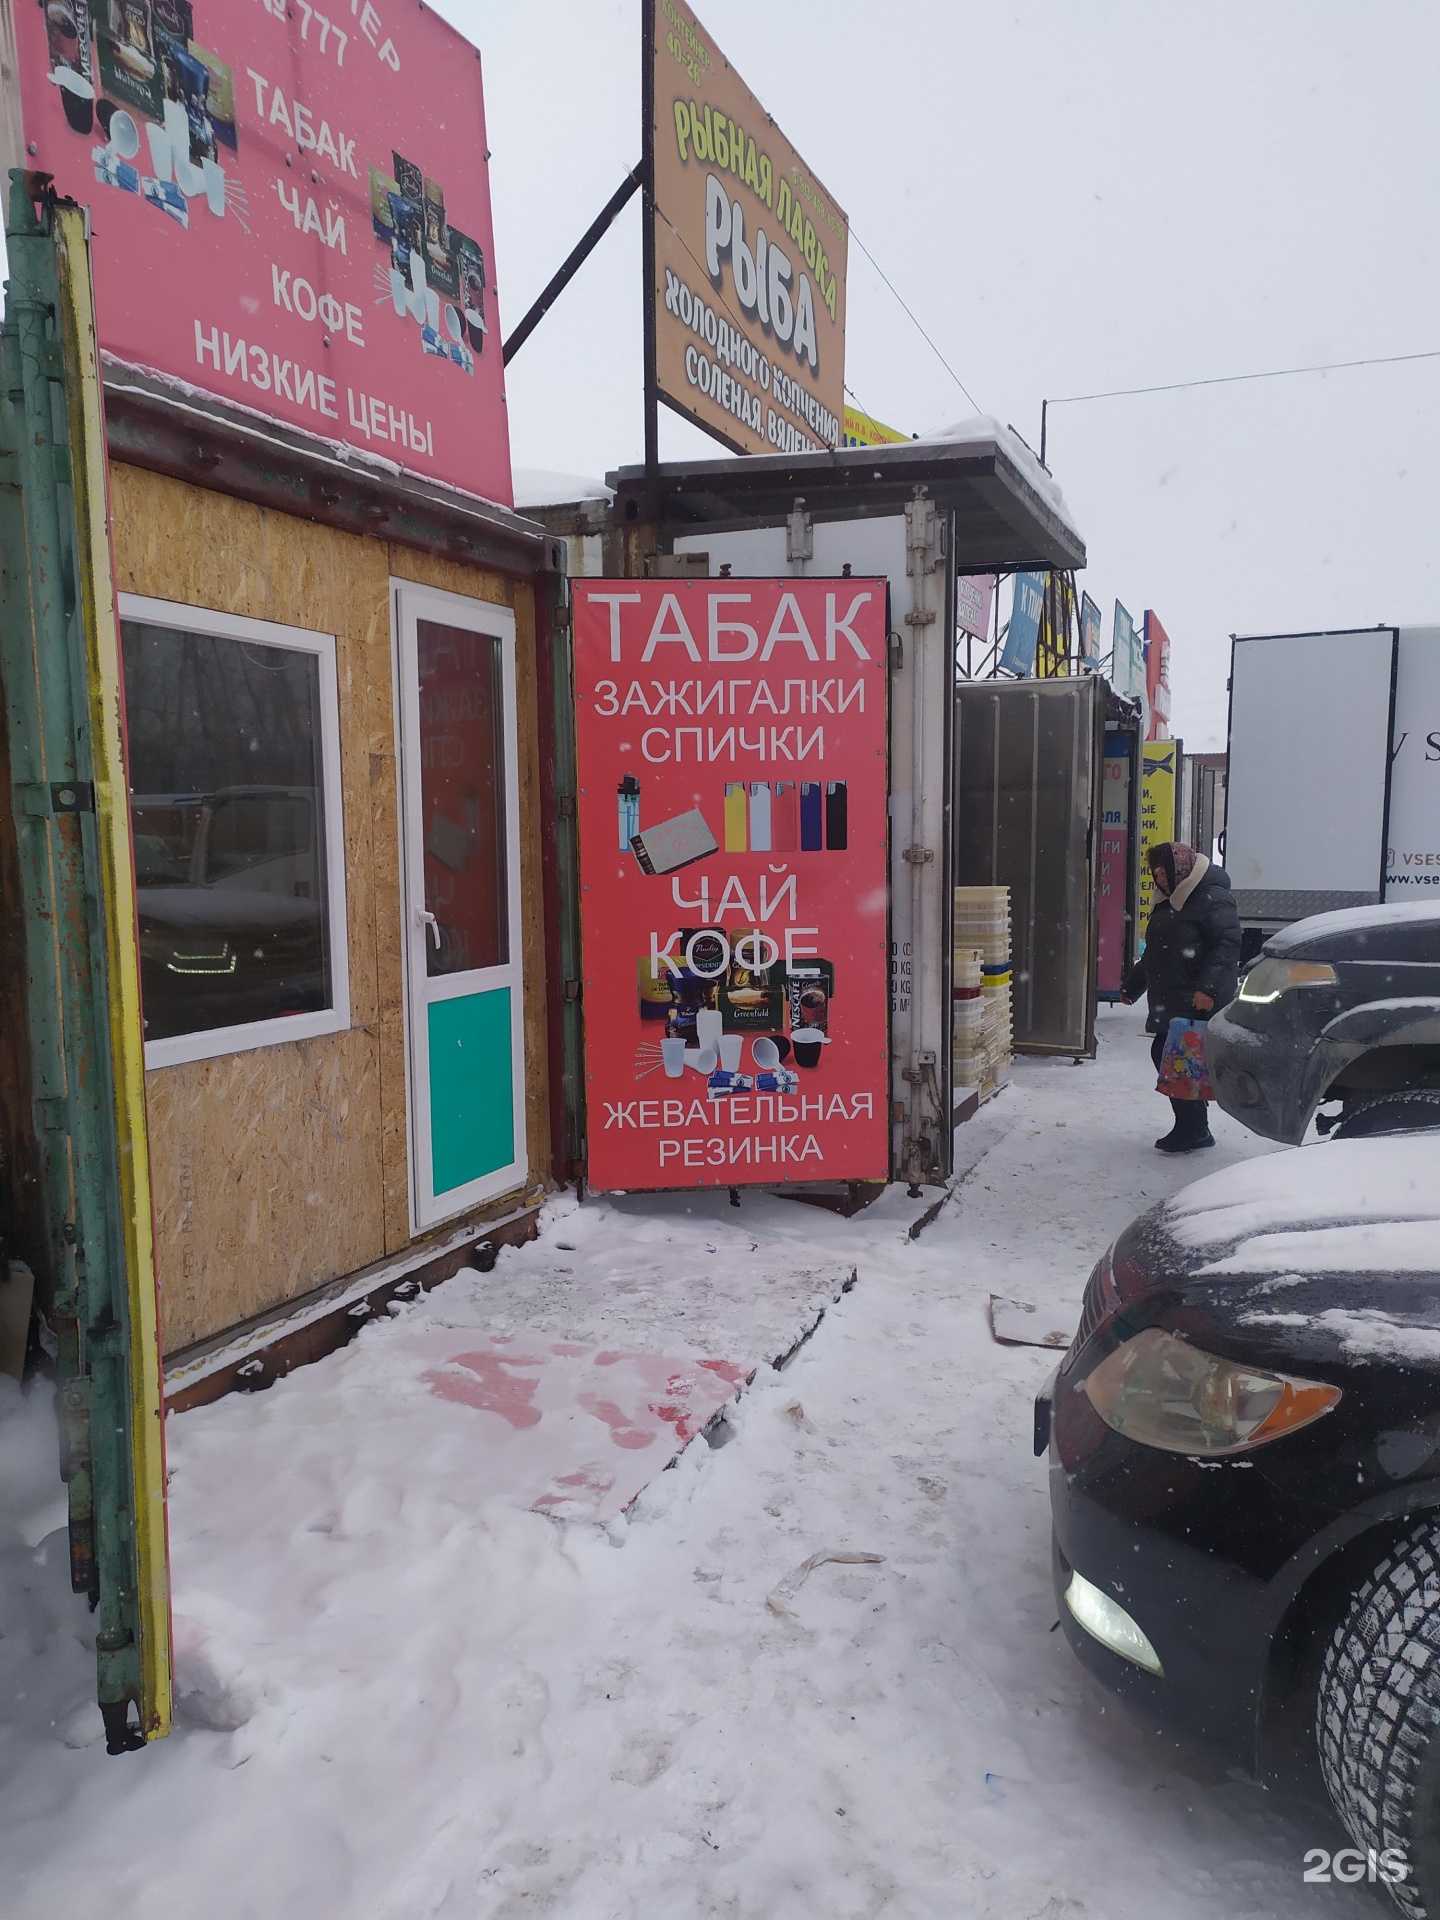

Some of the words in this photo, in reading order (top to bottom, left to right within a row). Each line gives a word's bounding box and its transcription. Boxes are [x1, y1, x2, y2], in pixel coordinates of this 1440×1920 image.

[296, 0, 349, 67] 777
[246, 67, 359, 179] ТАБАК
[276, 178, 348, 257] ЧАЙ
[674, 100, 772, 208] РЫБНАЯ
[777, 179, 838, 321] ЛАВКА
[271, 263, 366, 348] КОФЕ
[705, 173, 819, 367] РЫБА
[194, 319, 340, 420] НИЗКИЕ
[347, 386, 434, 458] ЦЕНЫ
[665, 269, 771, 390] ХОЛОДНОГО
[773, 366, 839, 448] КОПЧЕНИЯ
[685, 344, 765, 441] СОЛЕНАЯ,
[587, 592, 873, 663] ТАБАК
[593, 678, 866, 716] ЗАЖИГАЛКИ
[640, 725, 825, 763] СПИЧКИ
[671, 863, 798, 923] ЧАЙ
[650, 927, 821, 979] КОФЕ
[733, 1007, 769, 1019] Greenfield
[602, 1092, 874, 1129] ЖЕВАТЕЛЬНАЯ
[658, 1134, 825, 1168] РЕЗИНКА
